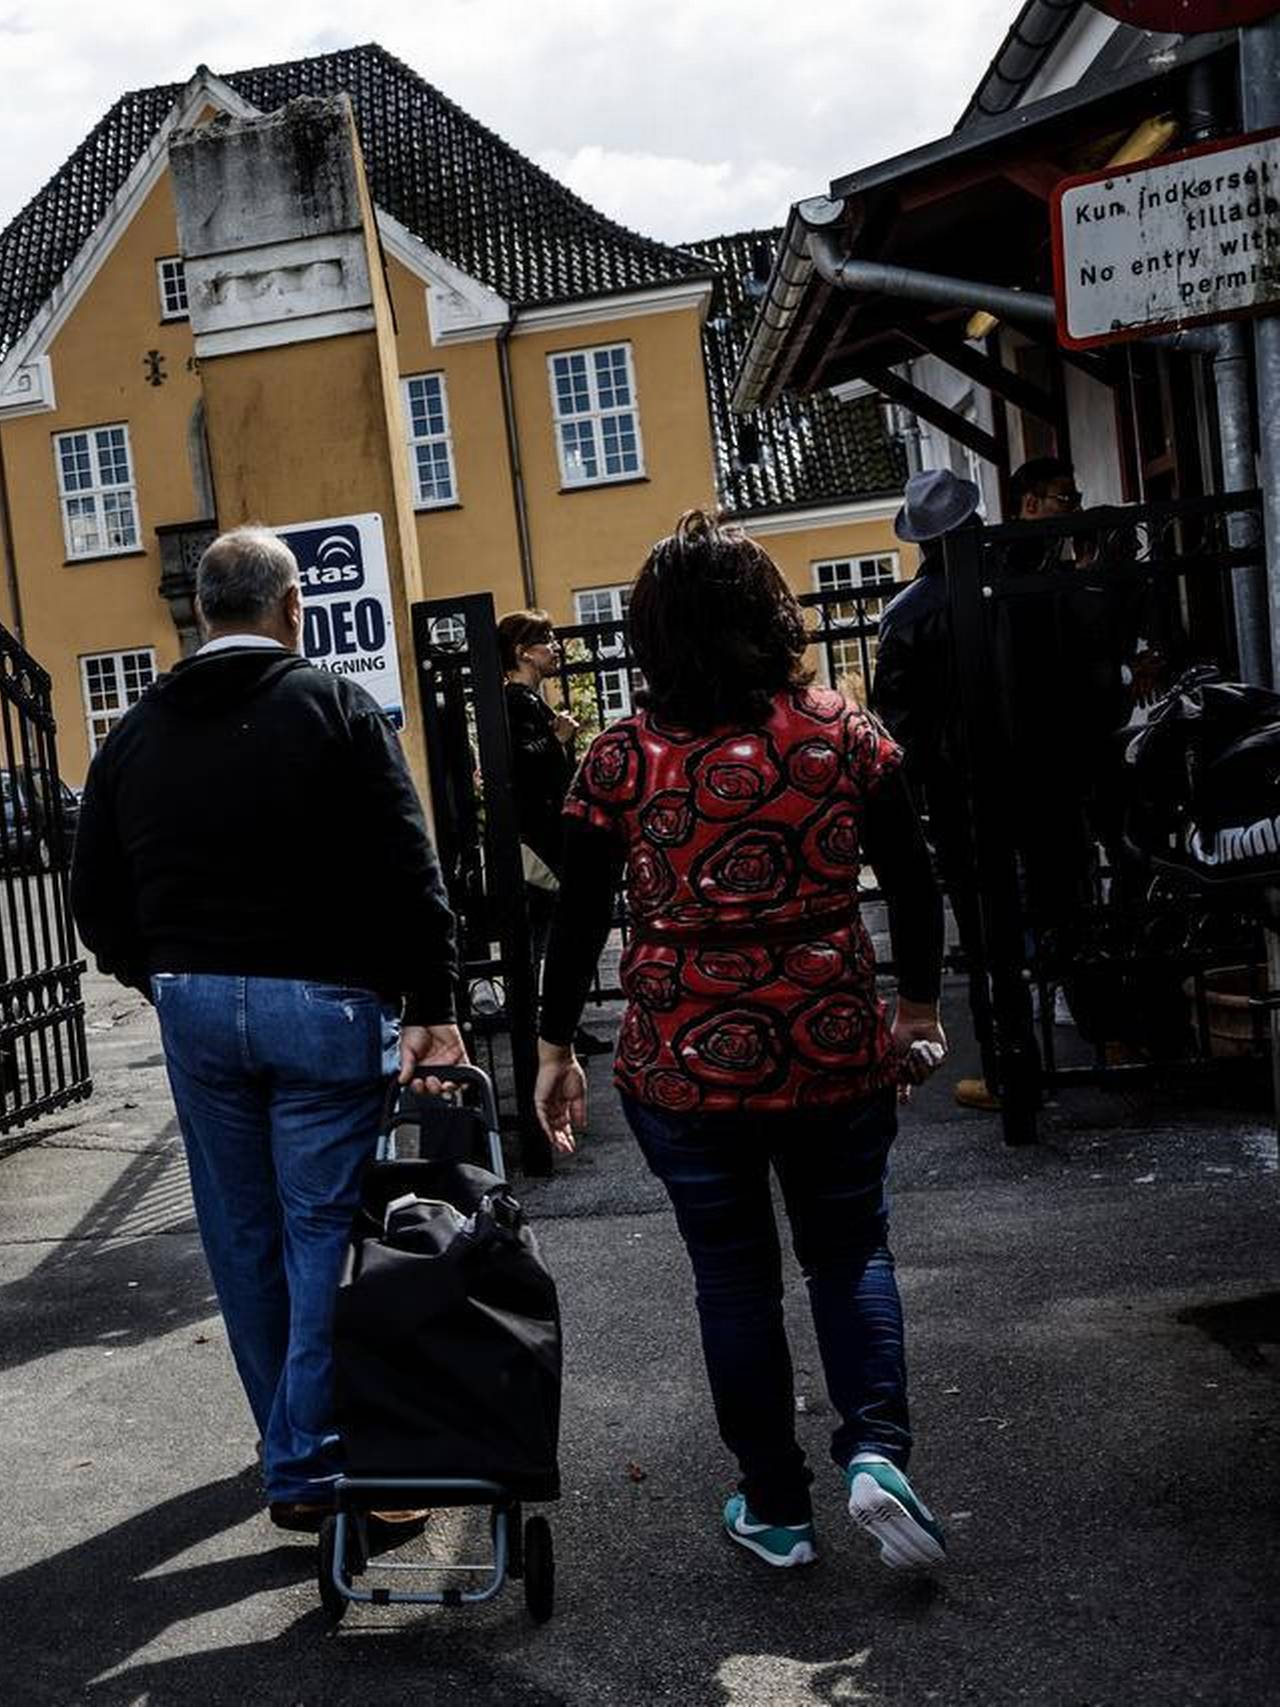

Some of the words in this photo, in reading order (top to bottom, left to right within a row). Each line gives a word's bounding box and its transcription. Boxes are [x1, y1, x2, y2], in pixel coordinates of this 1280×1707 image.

[1076, 202, 1122, 224] Kun
[1081, 265, 1114, 286] No
[1131, 247, 1201, 275] entry
